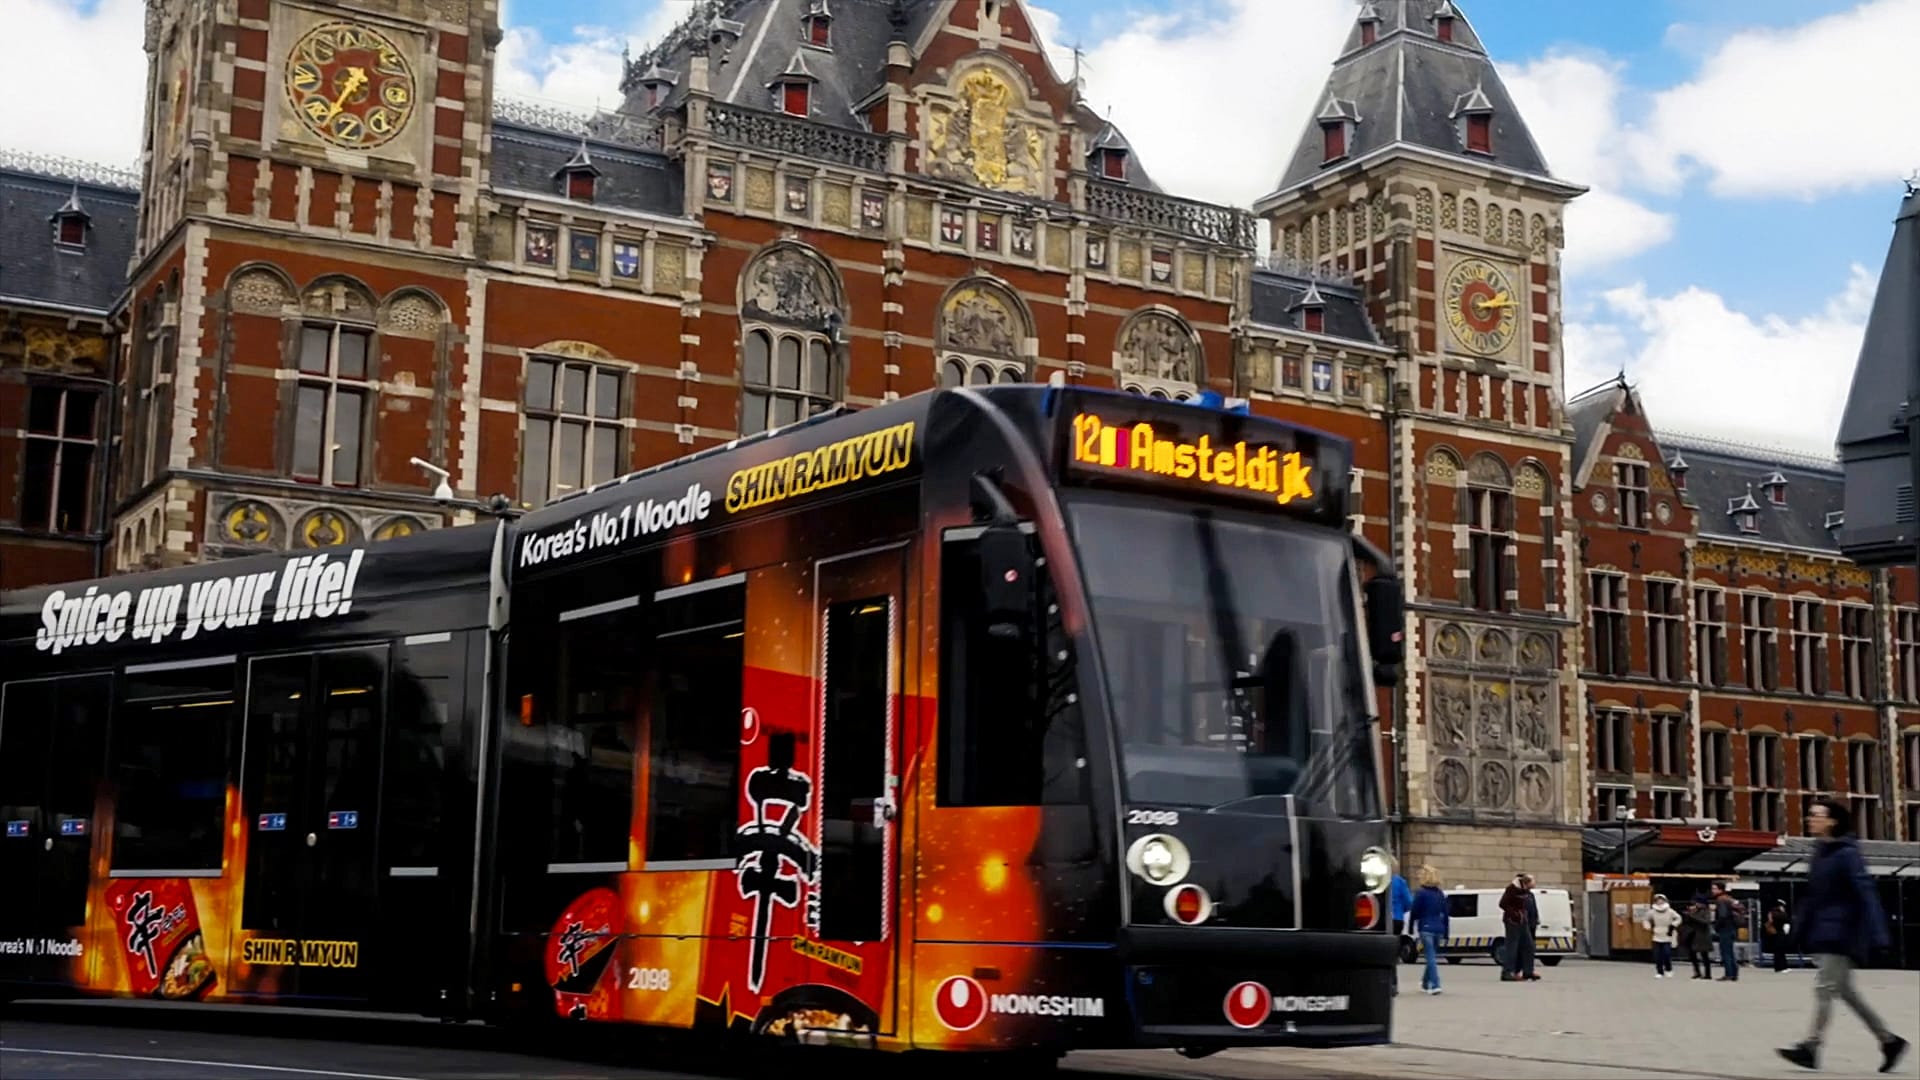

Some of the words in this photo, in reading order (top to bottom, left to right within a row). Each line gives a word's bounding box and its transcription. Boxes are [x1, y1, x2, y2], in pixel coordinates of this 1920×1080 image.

[1073, 413, 1101, 464] 12
[1130, 423, 1313, 505] Amsteldijk
[520, 518, 588, 568] Korea's
[633, 483, 713, 539] Noodle
[35, 586, 132, 656] Spice
[131, 583, 184, 644] up
[180, 570, 278, 641] your
[272, 548, 366, 623] life!
[46, 938, 84, 957] Noodle
[628, 967, 671, 991] 2098
[990, 994, 1105, 1017] NONGSHIM
